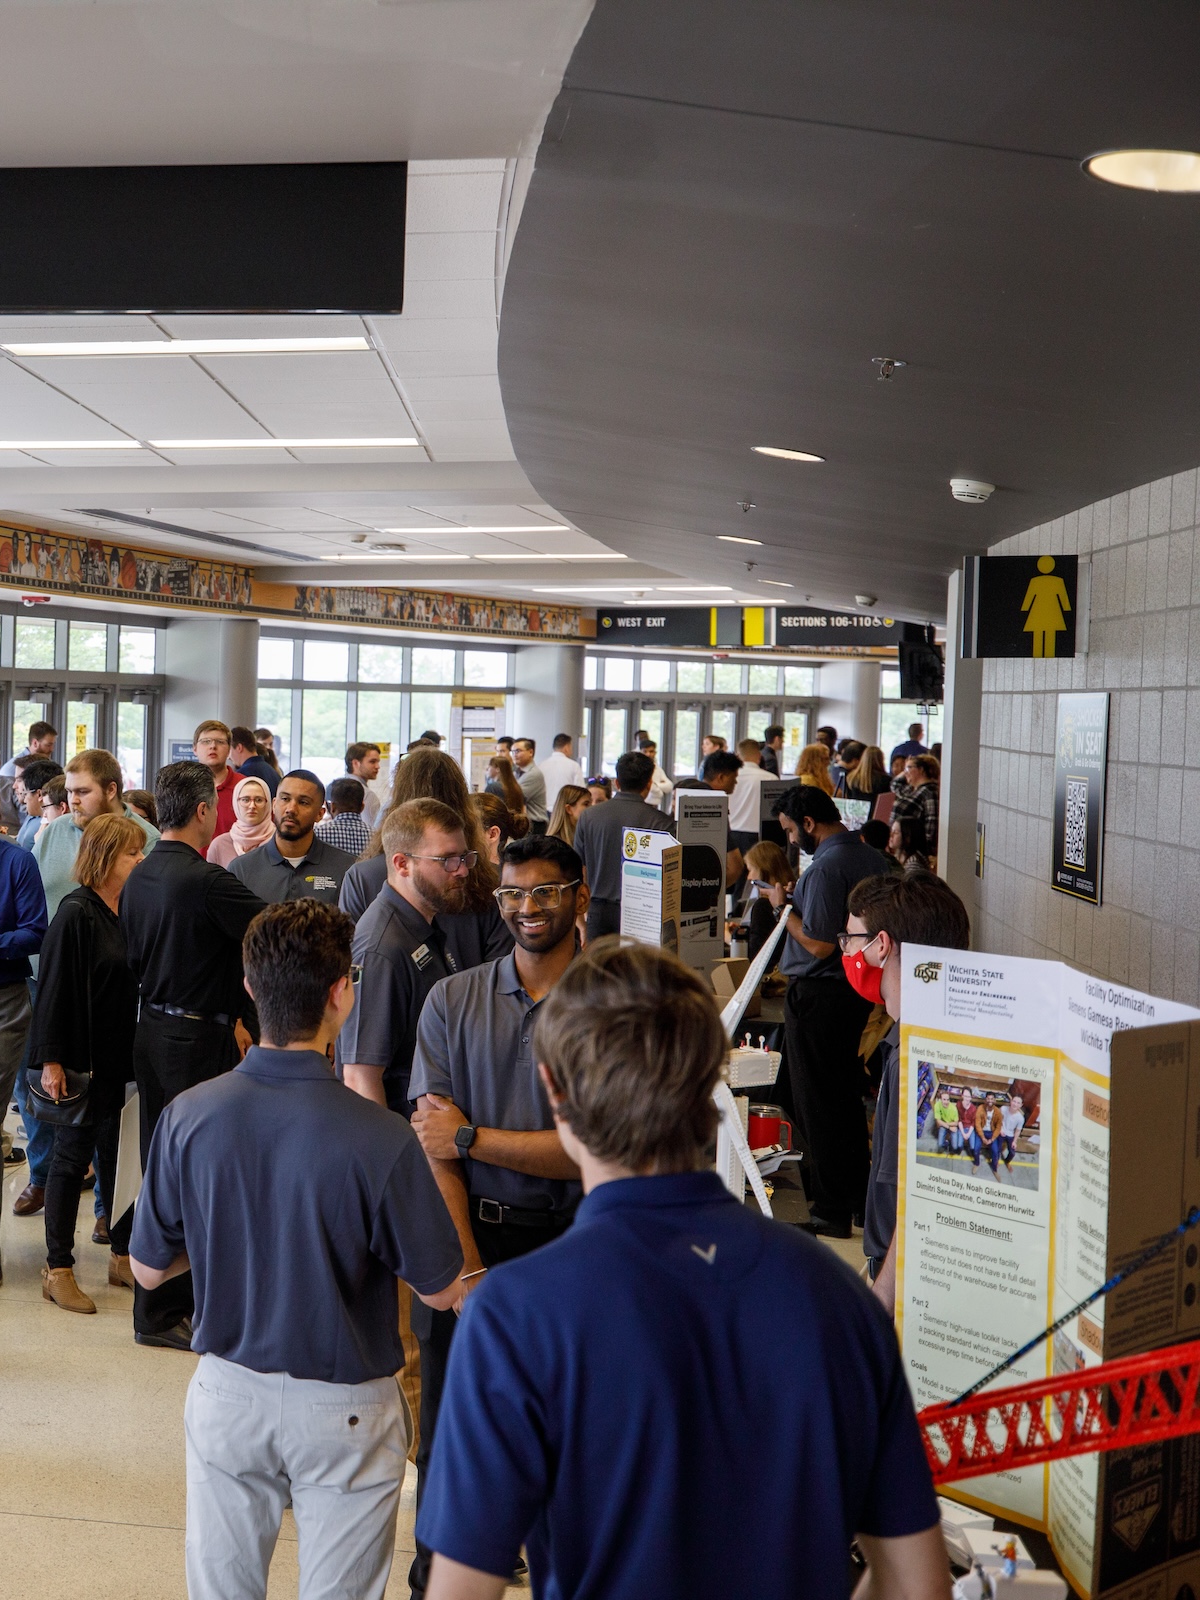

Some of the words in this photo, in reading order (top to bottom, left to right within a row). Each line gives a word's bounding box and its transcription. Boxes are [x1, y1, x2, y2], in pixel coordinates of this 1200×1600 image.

[617, 617, 642, 628] WEST
[646, 617, 666, 628] EXIT
[781, 616, 827, 627] SECTIONS
[830, 616, 872, 627] 106-110
[1086, 732, 1102, 756] SEAT
[682, 878, 702, 887] Display
[702, 878, 719, 886] Board
[949, 965, 979, 976] WICHITA
[982, 969, 1004, 979] STATE
[949, 974, 992, 987] UNIVERSITY
[1086, 980, 1107, 1004] Facility
[1108, 988, 1155, 1018] Optimization
[1088, 1007, 1113, 1028] Gamesa
[1081, 1028, 1103, 1051] Wichita
[912, 1046, 926, 1056] Meet
[926, 1048, 936, 1057] the
[955, 1054, 992, 1068] (Referenced
[993, 1062, 1008, 1071] from
[1009, 1065, 1020, 1073] left
[916, 1180, 936, 1192] Dimitri
[937, 1186, 975, 1203] Seneviratne,
[976, 1196, 1006, 1210] Cameron
[1008, 1204, 1035, 1216] Hurwitz
[928, 1174, 950, 1186] Joshua
[951, 1179, 964, 1190] Day,
[966, 1184, 983, 1193] Noah
[985, 1187, 1019, 1202] Glickman,
[914, 1221, 927, 1231] Part
[936, 1212, 967, 1228] Problem
[969, 1221, 1013, 1240] Statement:
[925, 1237, 949, 1250] Siemens
[950, 1245, 964, 1255] aims
[965, 1249, 971, 1257] to
[973, 1251, 998, 1264] improve
[999, 1257, 1020, 1271] facility
[947, 1256, 956, 1266] but
[958, 1259, 972, 1270] does
[974, 1264, 984, 1273] not
[920, 1261, 928, 1270] 2d
[928, 1263, 945, 1275] layout
[947, 1269, 952, 1277] of
[953, 1271, 963, 1281] the
[964, 1274, 997, 1290] warehouse
[999, 1283, 1008, 1292] for
[920, 1274, 950, 1291] referencing
[912, 1296, 924, 1307] Part
[918, 1338, 945, 1352] excessive
[947, 1347, 960, 1358] prep
[961, 1351, 974, 1362] time
[924, 1328, 945, 1341] packing
[946, 1335, 972, 1348] standard
[973, 1343, 990, 1354] which
[982, 1332, 1000, 1343] toolkit
[1001, 1337, 1018, 1349] lacks
[911, 1360, 927, 1372] Goals
